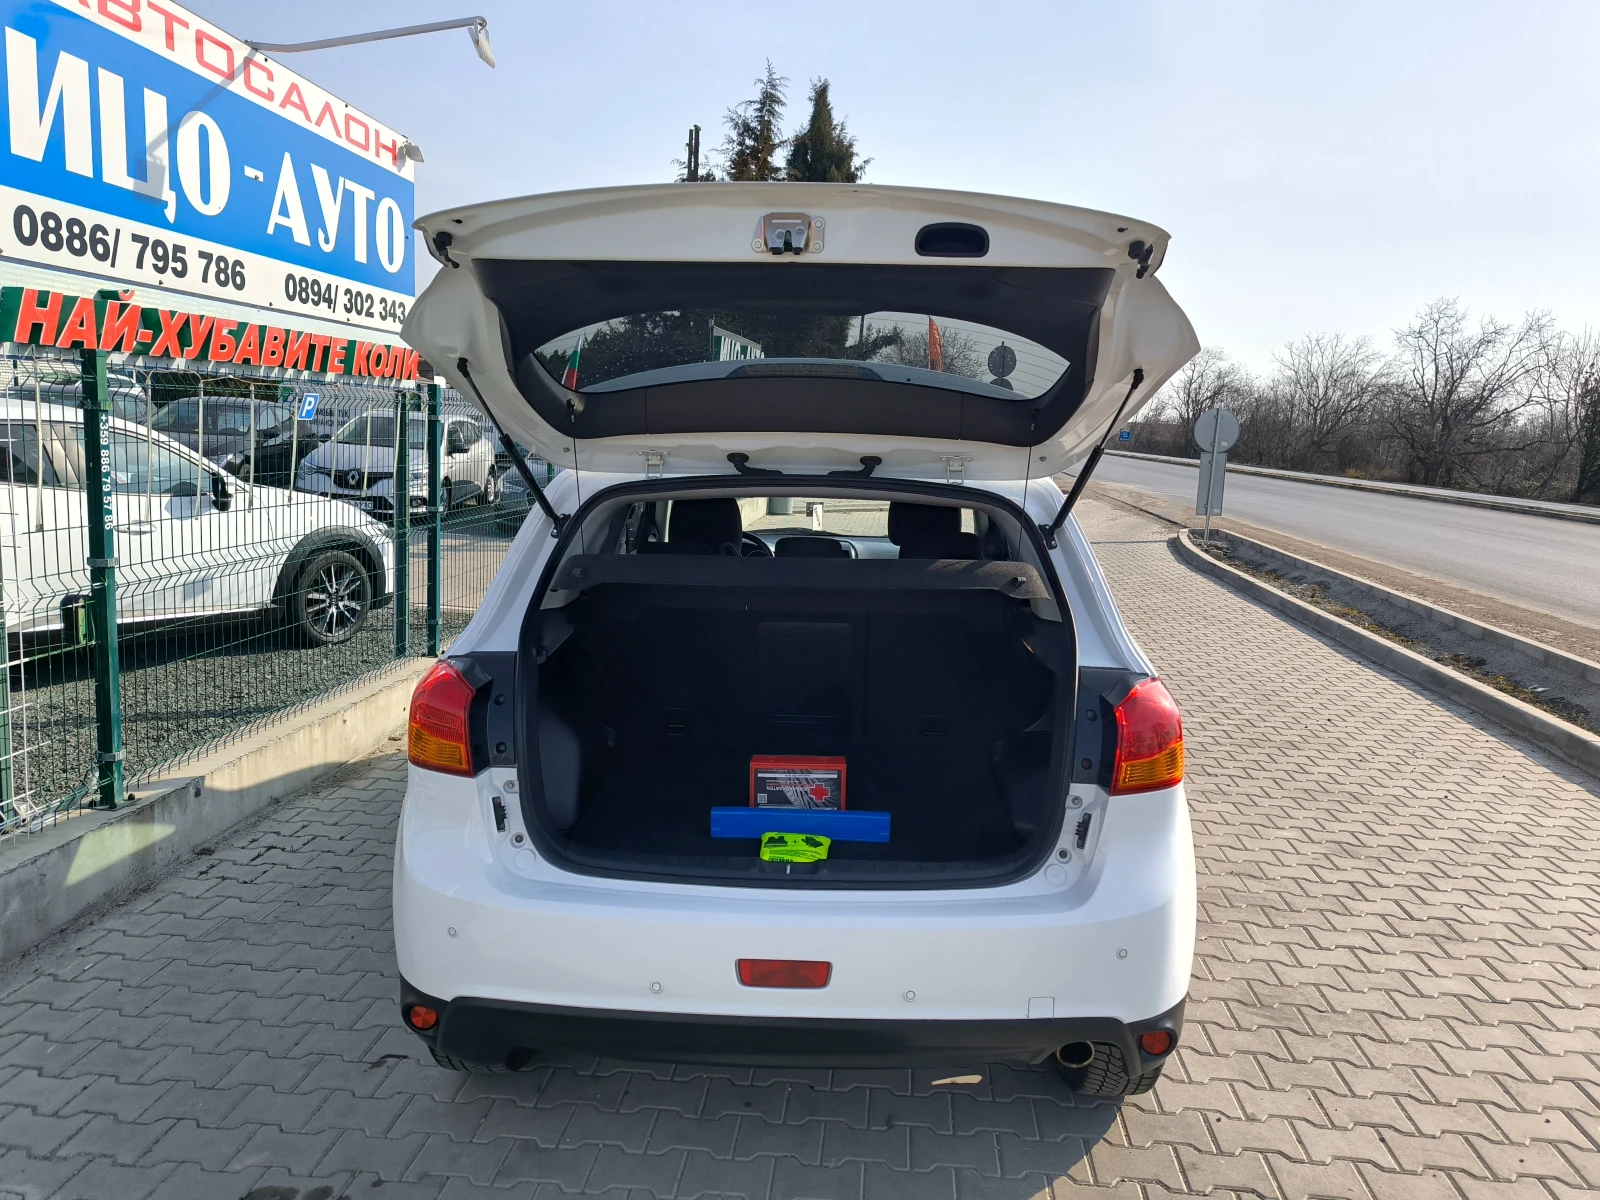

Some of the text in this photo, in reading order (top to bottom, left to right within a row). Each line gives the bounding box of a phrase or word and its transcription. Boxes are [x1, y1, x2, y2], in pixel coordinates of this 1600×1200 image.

[78, 0, 397, 167] ВТОСАЛОН
[13, 204, 246, 290] 0886/ 795 786
[14, 288, 419, 380] НАЙ-ХУБАВИТЕ КОЛИ
[284, 273, 405, 325] 0894/ 302 343
[302, 397, 315, 416] P
[100, 414, 113, 530] +359 886 79 57 86
